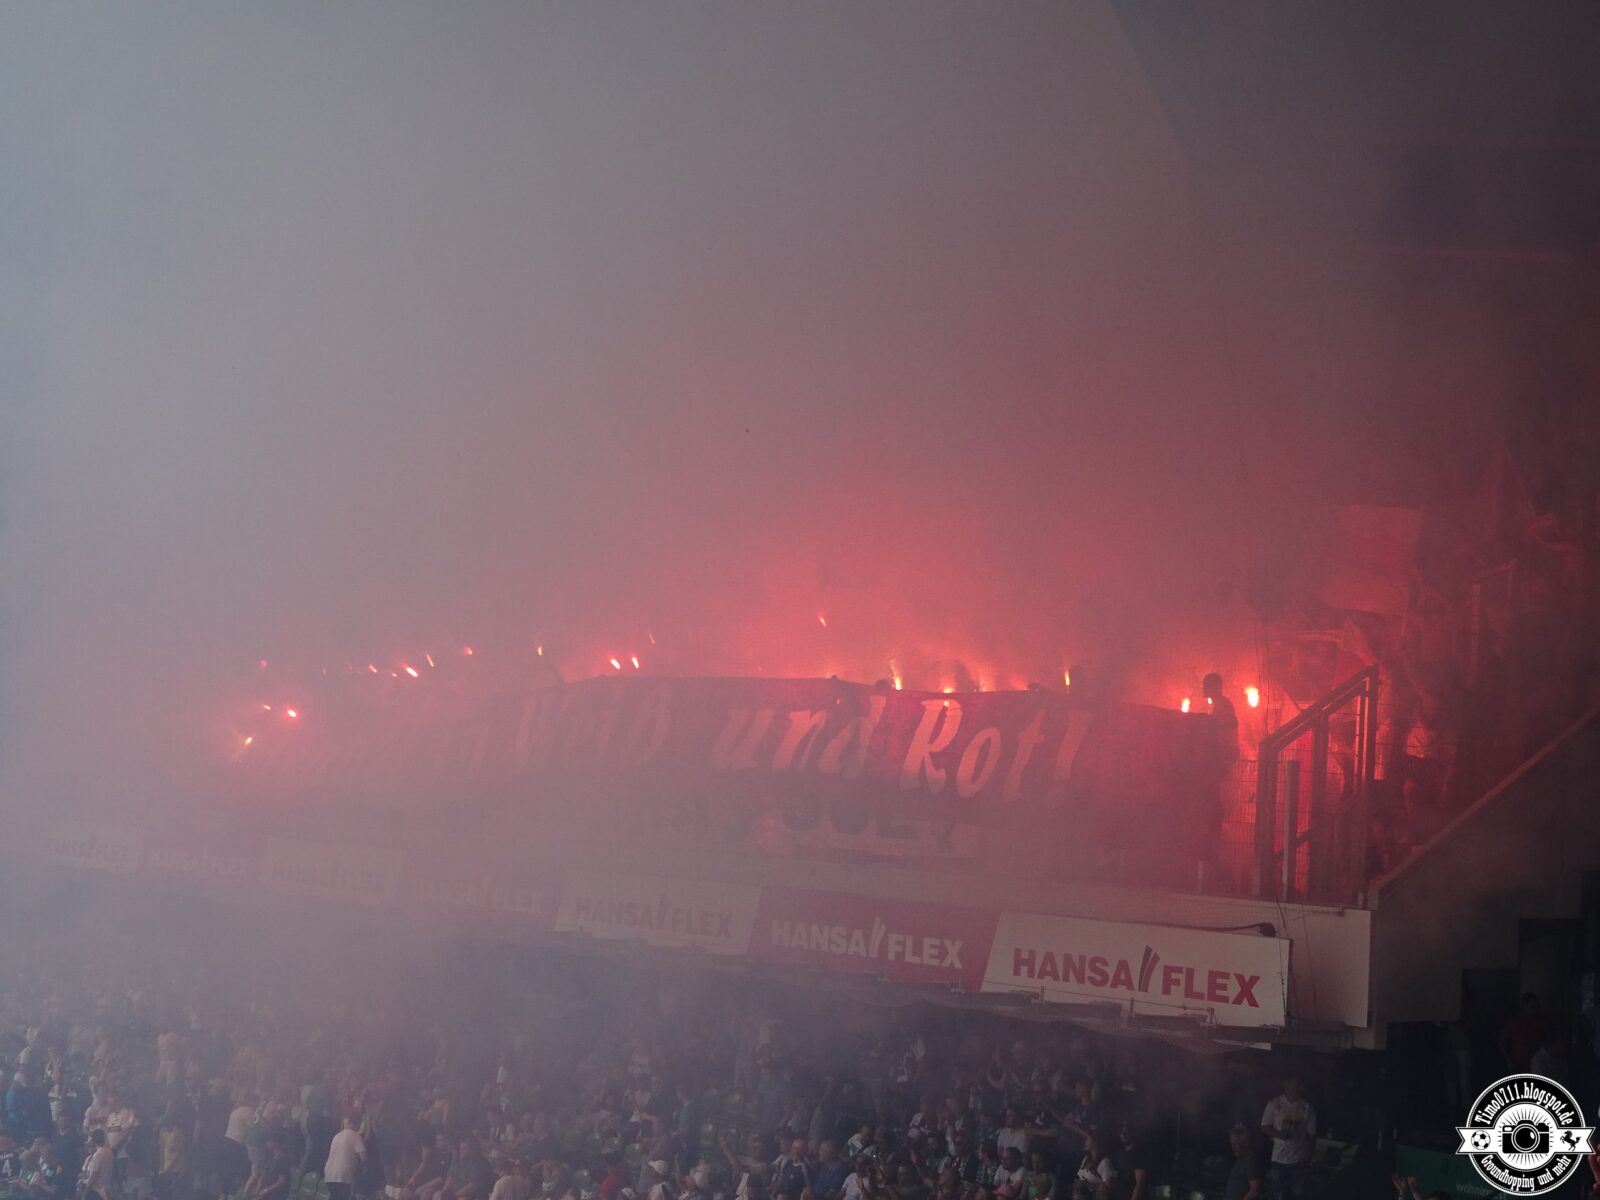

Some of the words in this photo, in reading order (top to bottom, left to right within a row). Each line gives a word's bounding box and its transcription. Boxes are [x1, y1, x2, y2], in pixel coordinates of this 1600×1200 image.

[710, 694, 887, 778] und
[901, 697, 1092, 810] Rot!
[575, 897, 655, 930] HANSA
[671, 907, 732, 939] FLEX
[771, 919, 867, 957] HANSA
[887, 934, 963, 969] FLEX
[1012, 947, 1135, 991] HANSA
[1162, 964, 1261, 1008] FLEX
